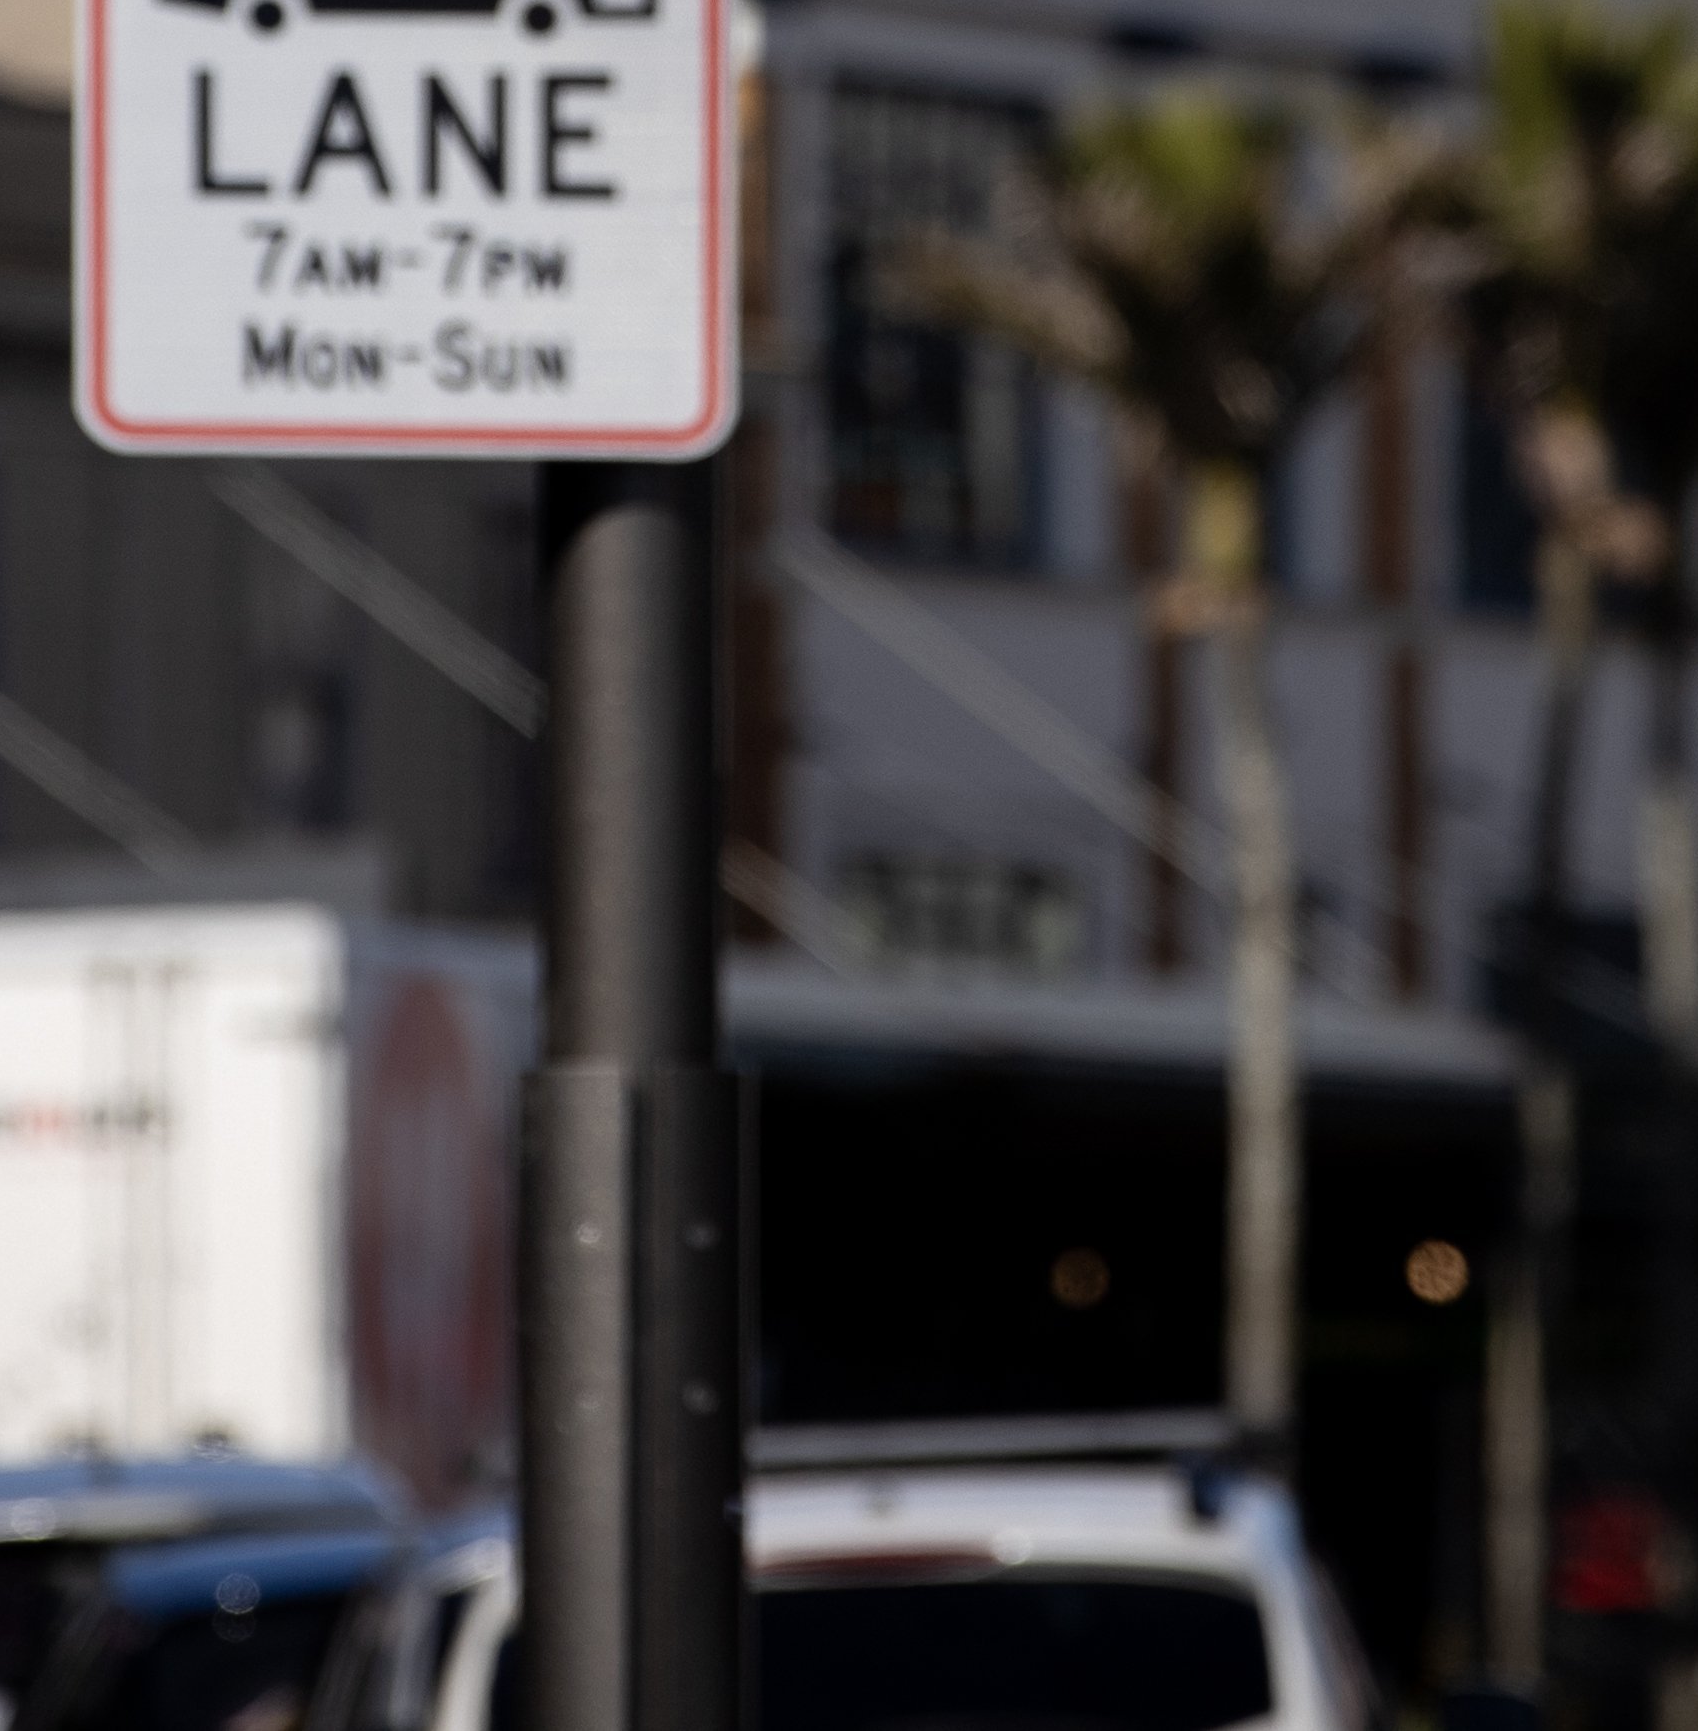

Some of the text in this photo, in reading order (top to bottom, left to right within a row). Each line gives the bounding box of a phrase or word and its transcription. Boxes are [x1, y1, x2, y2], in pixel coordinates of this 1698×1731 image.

[191, 67, 620, 204] LANE
[248, 221, 572, 295] 7AM-7PM
[241, 320, 572, 394] MON-SUN
